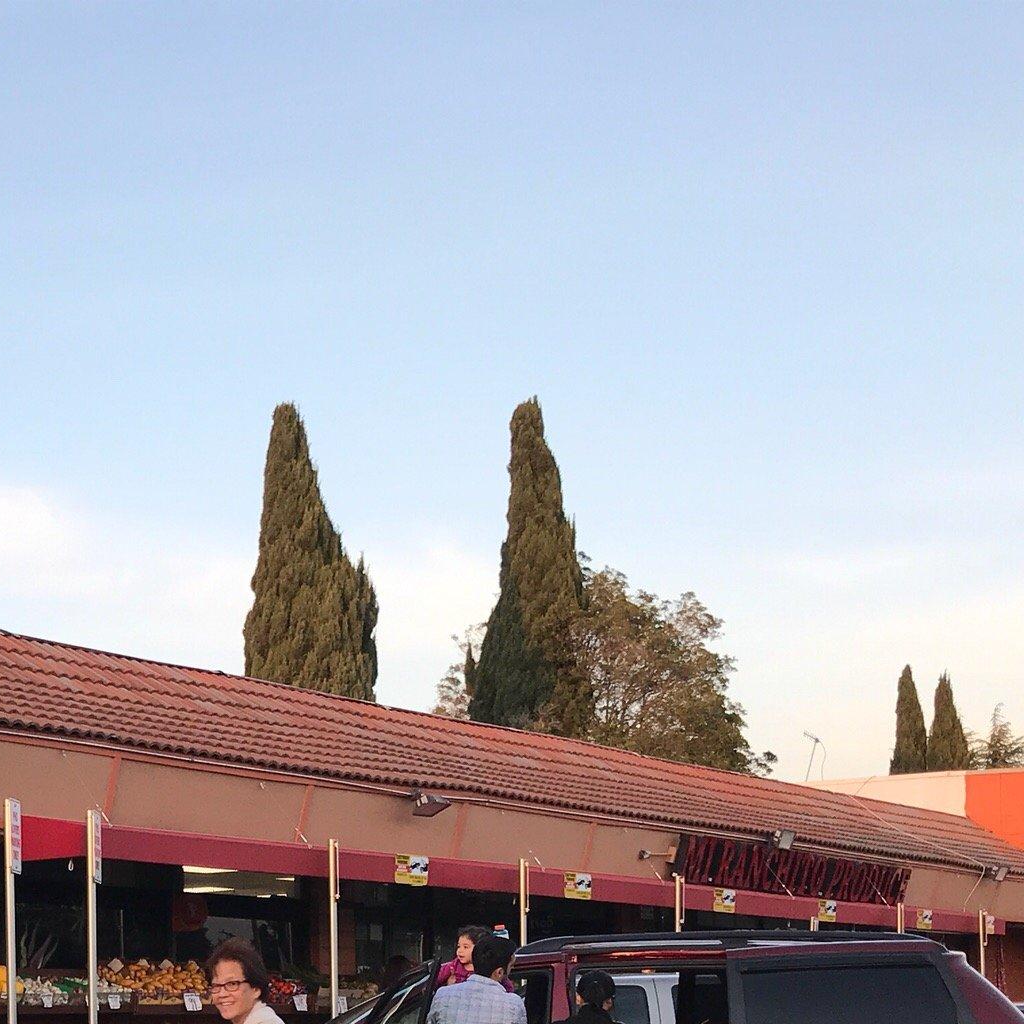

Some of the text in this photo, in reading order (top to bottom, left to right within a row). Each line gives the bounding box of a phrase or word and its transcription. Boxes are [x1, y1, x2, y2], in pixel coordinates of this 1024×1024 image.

[683, 834, 913, 904] MI RANCHITO PRODUCE
